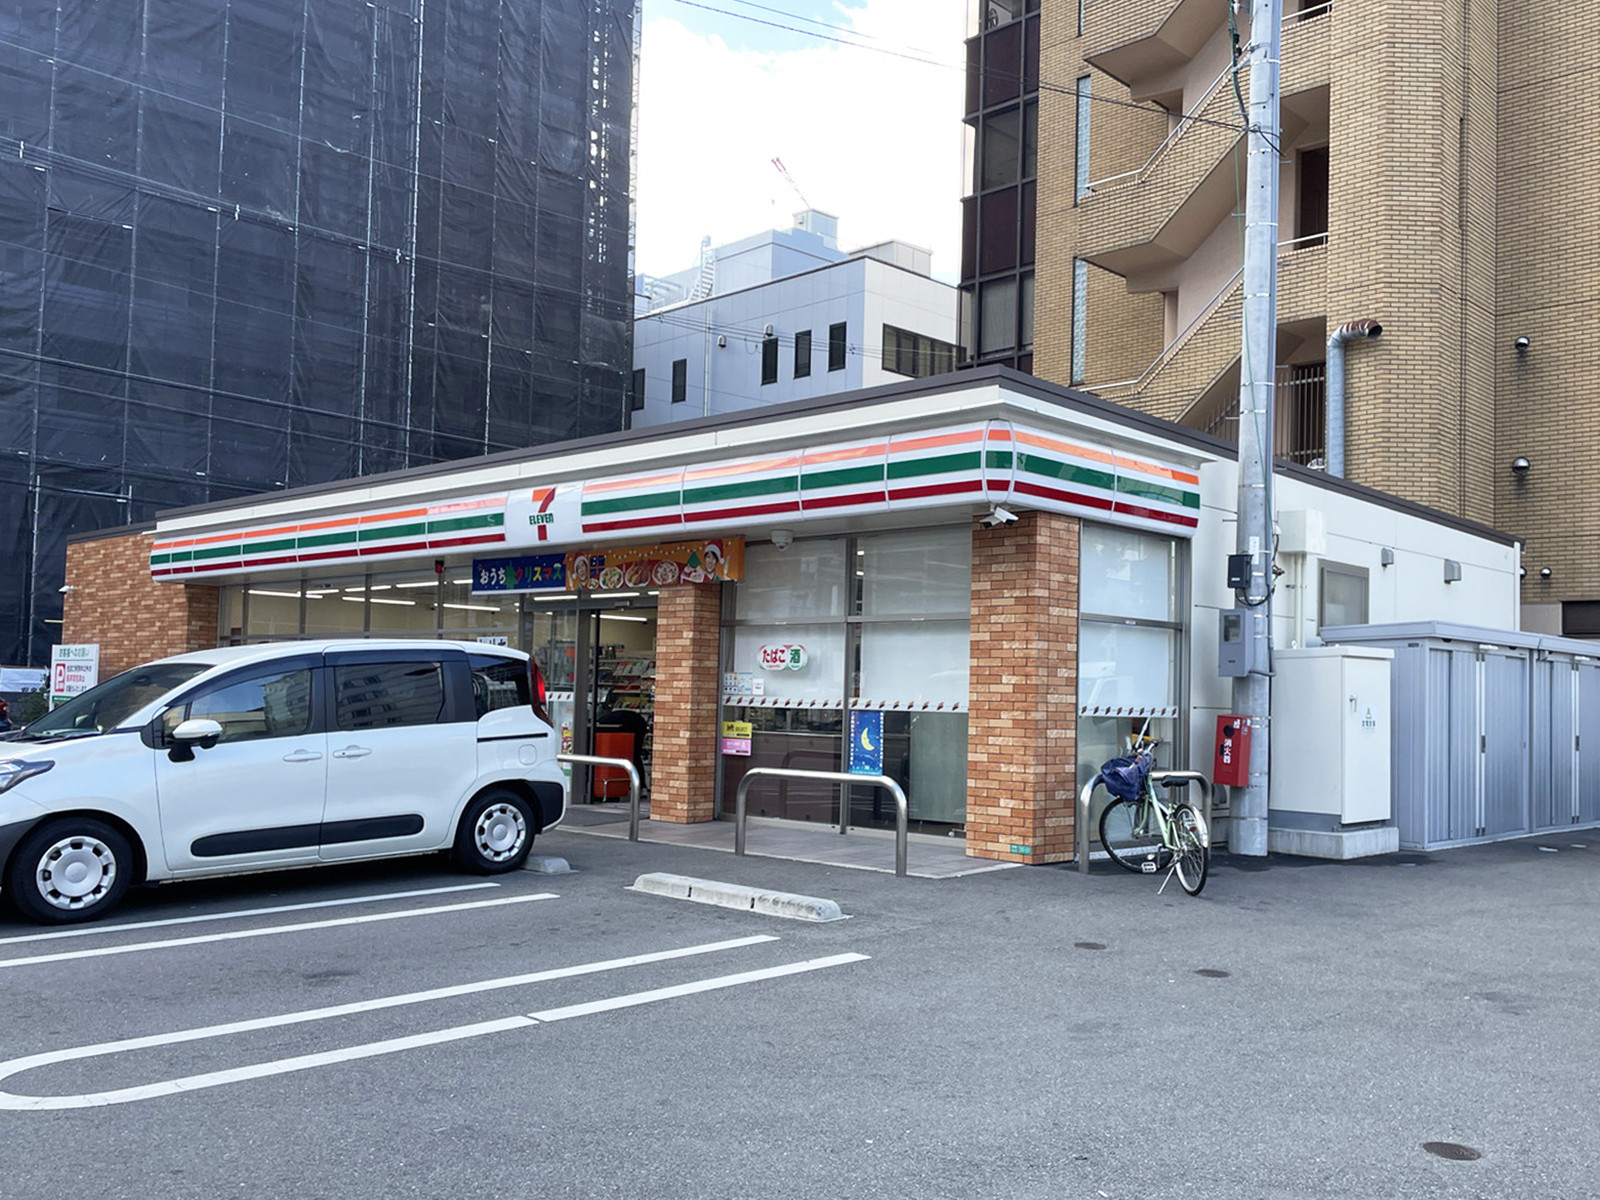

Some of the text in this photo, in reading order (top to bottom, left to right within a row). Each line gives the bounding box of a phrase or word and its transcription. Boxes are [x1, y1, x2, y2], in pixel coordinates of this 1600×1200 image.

[532, 487, 556, 541] 7
[480, 563, 562, 585] おうち クリスマス
[762, 649, 801, 664] たばこ 酒
[1223, 738, 1232, 764] 消火器
